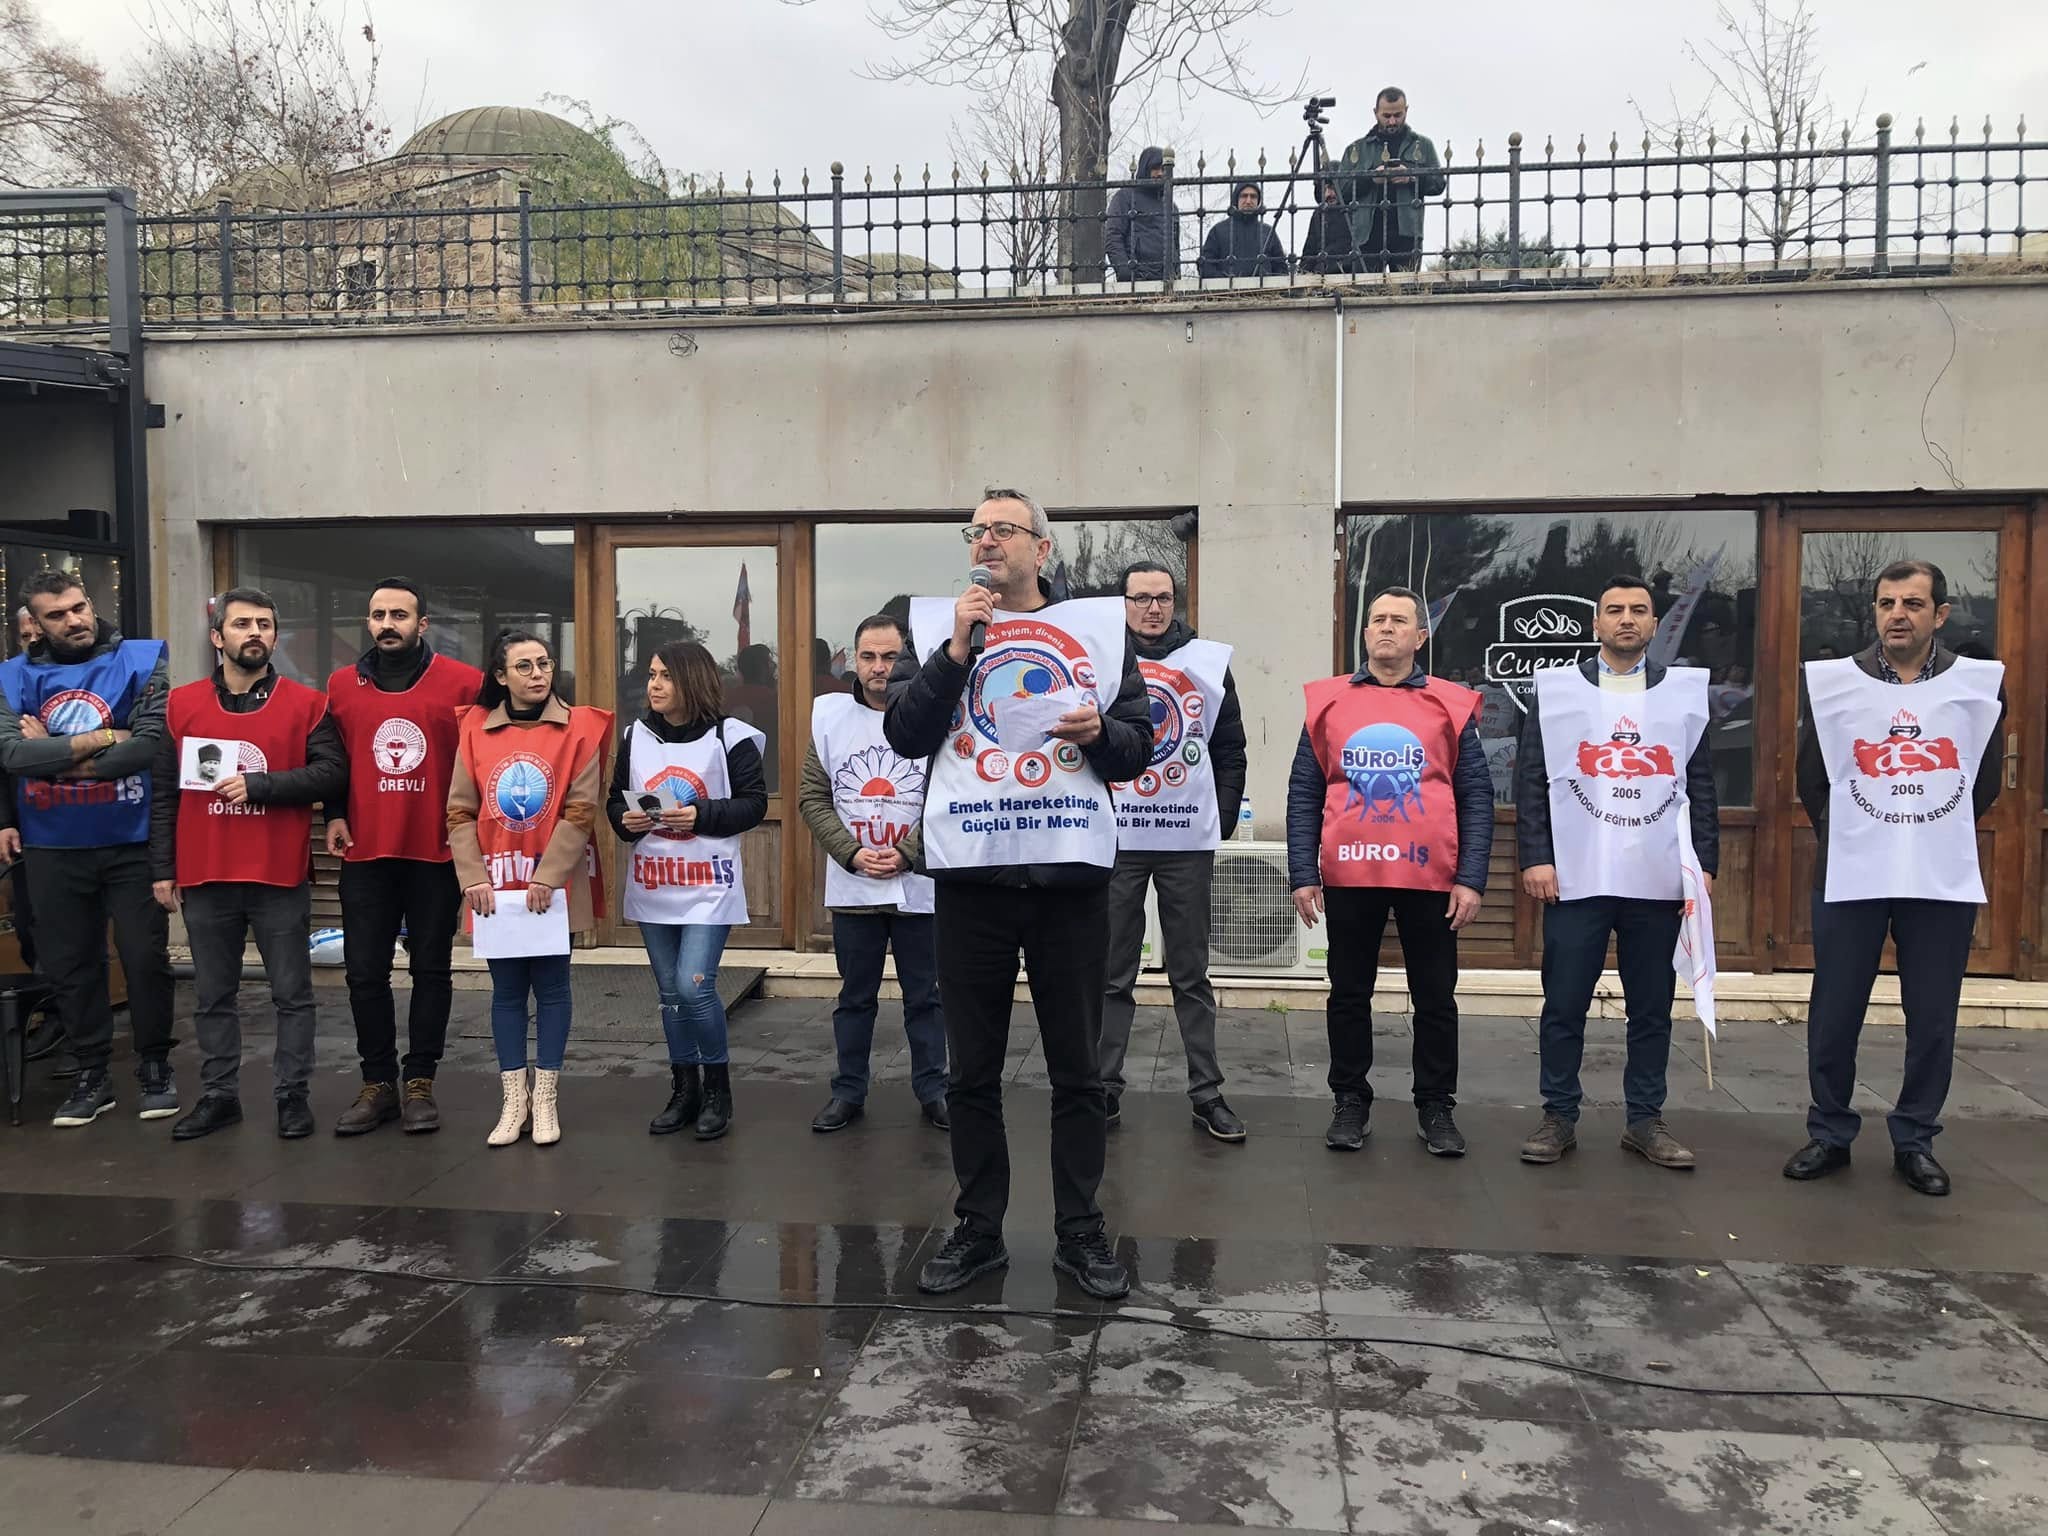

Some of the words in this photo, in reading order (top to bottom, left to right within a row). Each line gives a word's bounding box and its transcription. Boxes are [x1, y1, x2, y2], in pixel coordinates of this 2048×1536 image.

[1001, 627, 1032, 638] eylem,
[1342, 745, 1424, 770] BÜRO-İŞ
[377, 777, 426, 793] ÖREVLİ
[1612, 787, 1641, 800] 2005
[1891, 784, 1925, 796] 2005
[949, 799, 994, 814] Emek
[999, 795, 1099, 812] Hareketinde
[1121, 803, 1199, 814] Hareketinde
[1567, 779, 1603, 819] ANADOLU
[1604, 813, 1641, 827] EĞİTİM
[1849, 779, 1883, 819] ANADOLU
[1884, 812, 1926, 824] EĞİTİM
[1927, 774, 1966, 822] SENDİKASI
[850, 815, 909, 847] TÜM
[961, 817, 1010, 836] Güçlü
[1016, 816, 1042, 830] Bir
[1047, 815, 1090, 830] Mevzi
[1132, 818, 1151, 828] Bir
[1155, 818, 1191, 829] Mevzi
[1338, 841, 1429, 867] BÜRO-İŞ
